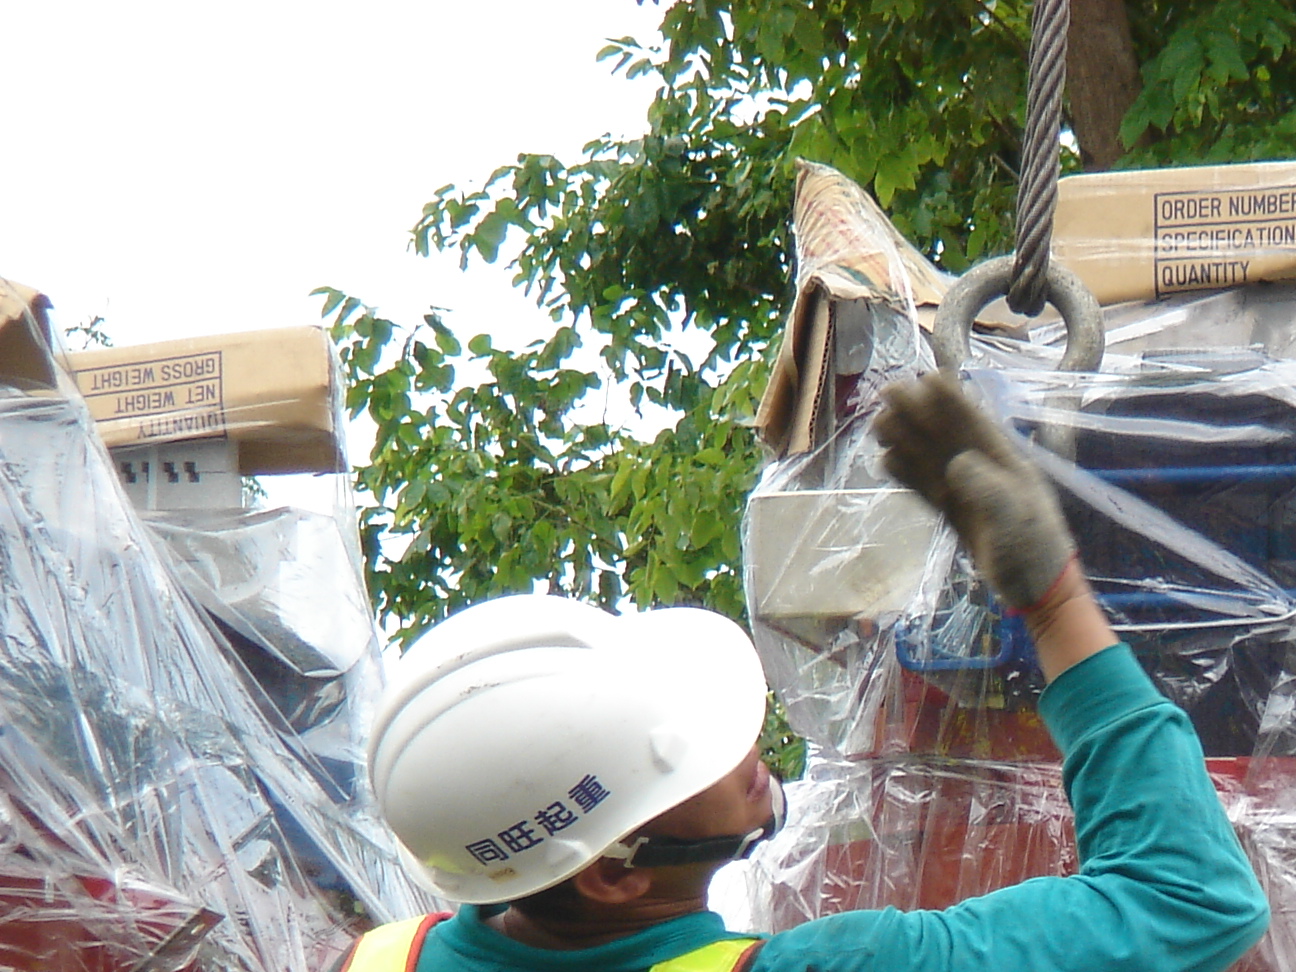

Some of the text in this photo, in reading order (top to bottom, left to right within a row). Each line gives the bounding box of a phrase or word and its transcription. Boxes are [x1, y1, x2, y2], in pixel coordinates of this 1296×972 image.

[1162, 198, 1222, 221] ORDER
[1162, 260, 1250, 287] QUANTITY
[91, 358, 215, 391] GROSS WEIGHT
[114, 384, 215, 414] NET WEIGHT
[137, 411, 220, 439] QUANTITY
[465, 774, 611, 866] 同旺起重
